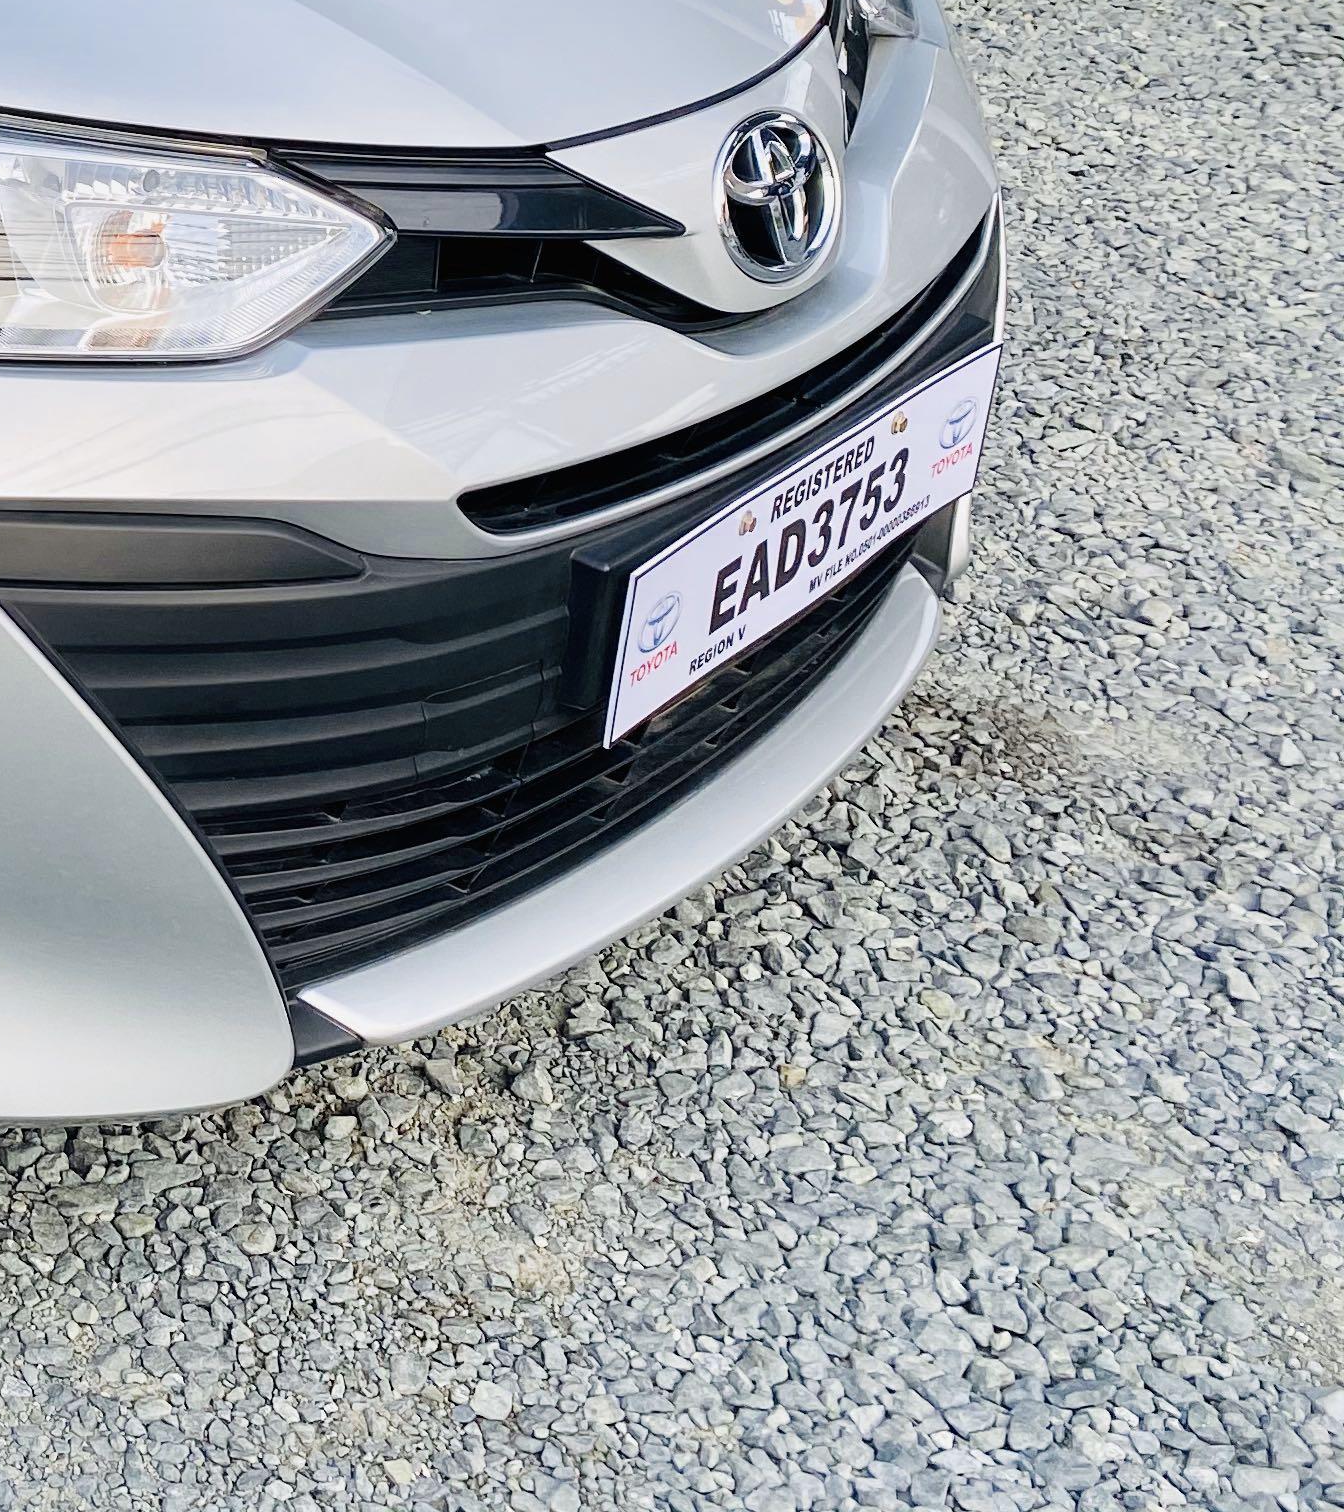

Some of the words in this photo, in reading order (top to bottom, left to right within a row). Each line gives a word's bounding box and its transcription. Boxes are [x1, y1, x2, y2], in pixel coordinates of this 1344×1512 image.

[771, 435, 875, 523] REGISTERED
[929, 442, 974, 478] TOYOTA
[708, 447, 910, 635] EAD3753
[825, 559, 844, 581] FILE
[630, 640, 679, 687] TOYOTA
[689, 635, 734, 676] REGION
[736, 625, 747, 642] V
